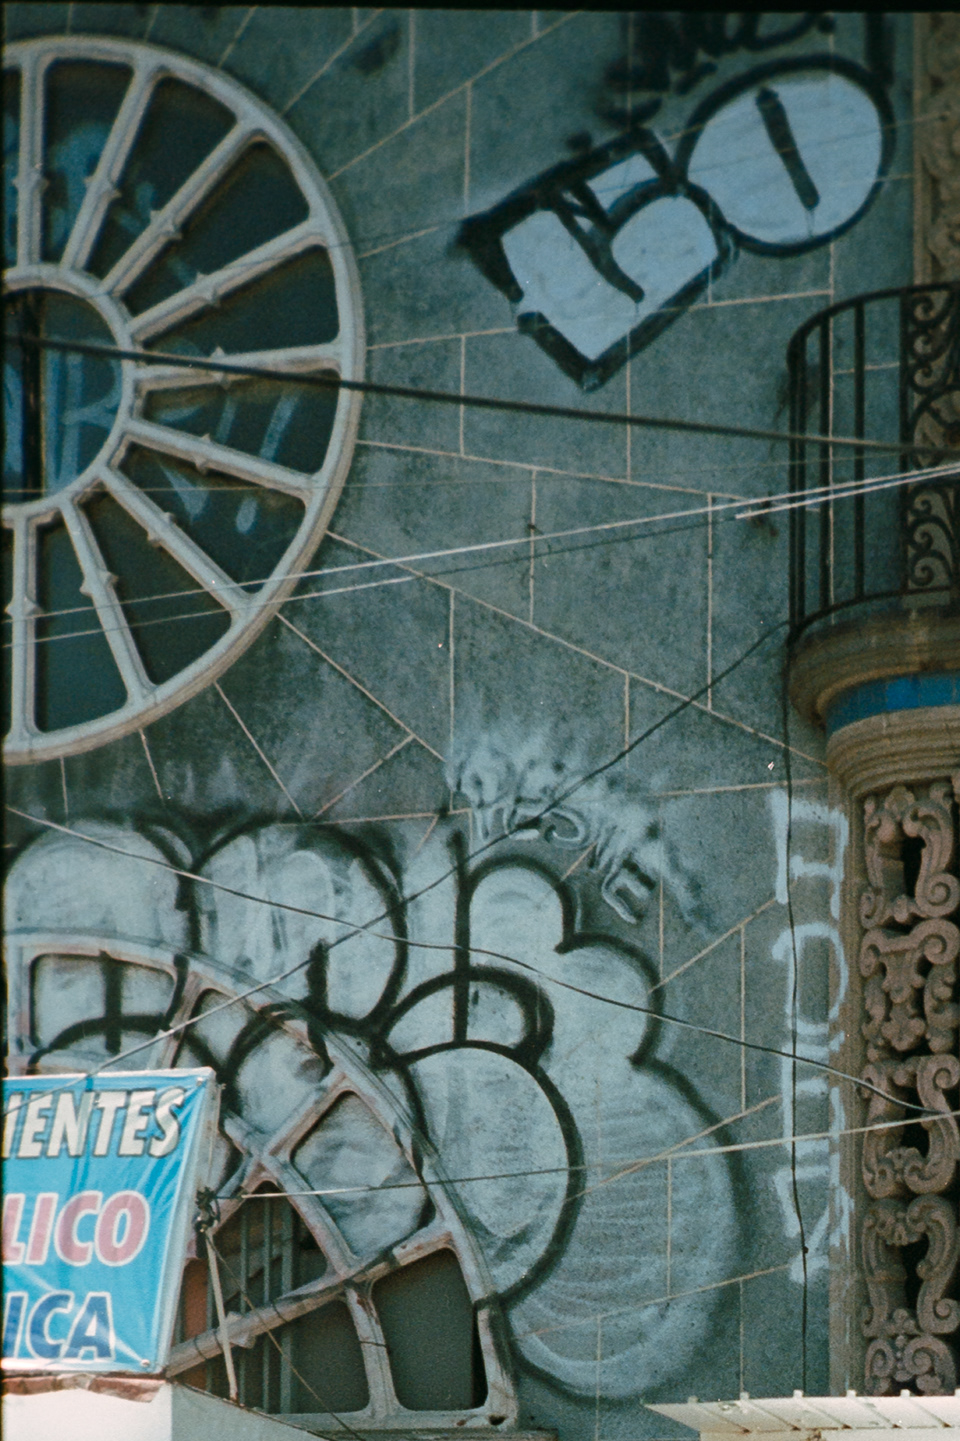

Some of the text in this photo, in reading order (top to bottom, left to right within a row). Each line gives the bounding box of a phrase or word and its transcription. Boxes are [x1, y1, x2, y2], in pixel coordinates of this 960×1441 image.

[3, 1086, 188, 1159] IENTES
[3, 1190, 150, 1267] LICO
[3, 1291, 116, 1362] ICA
